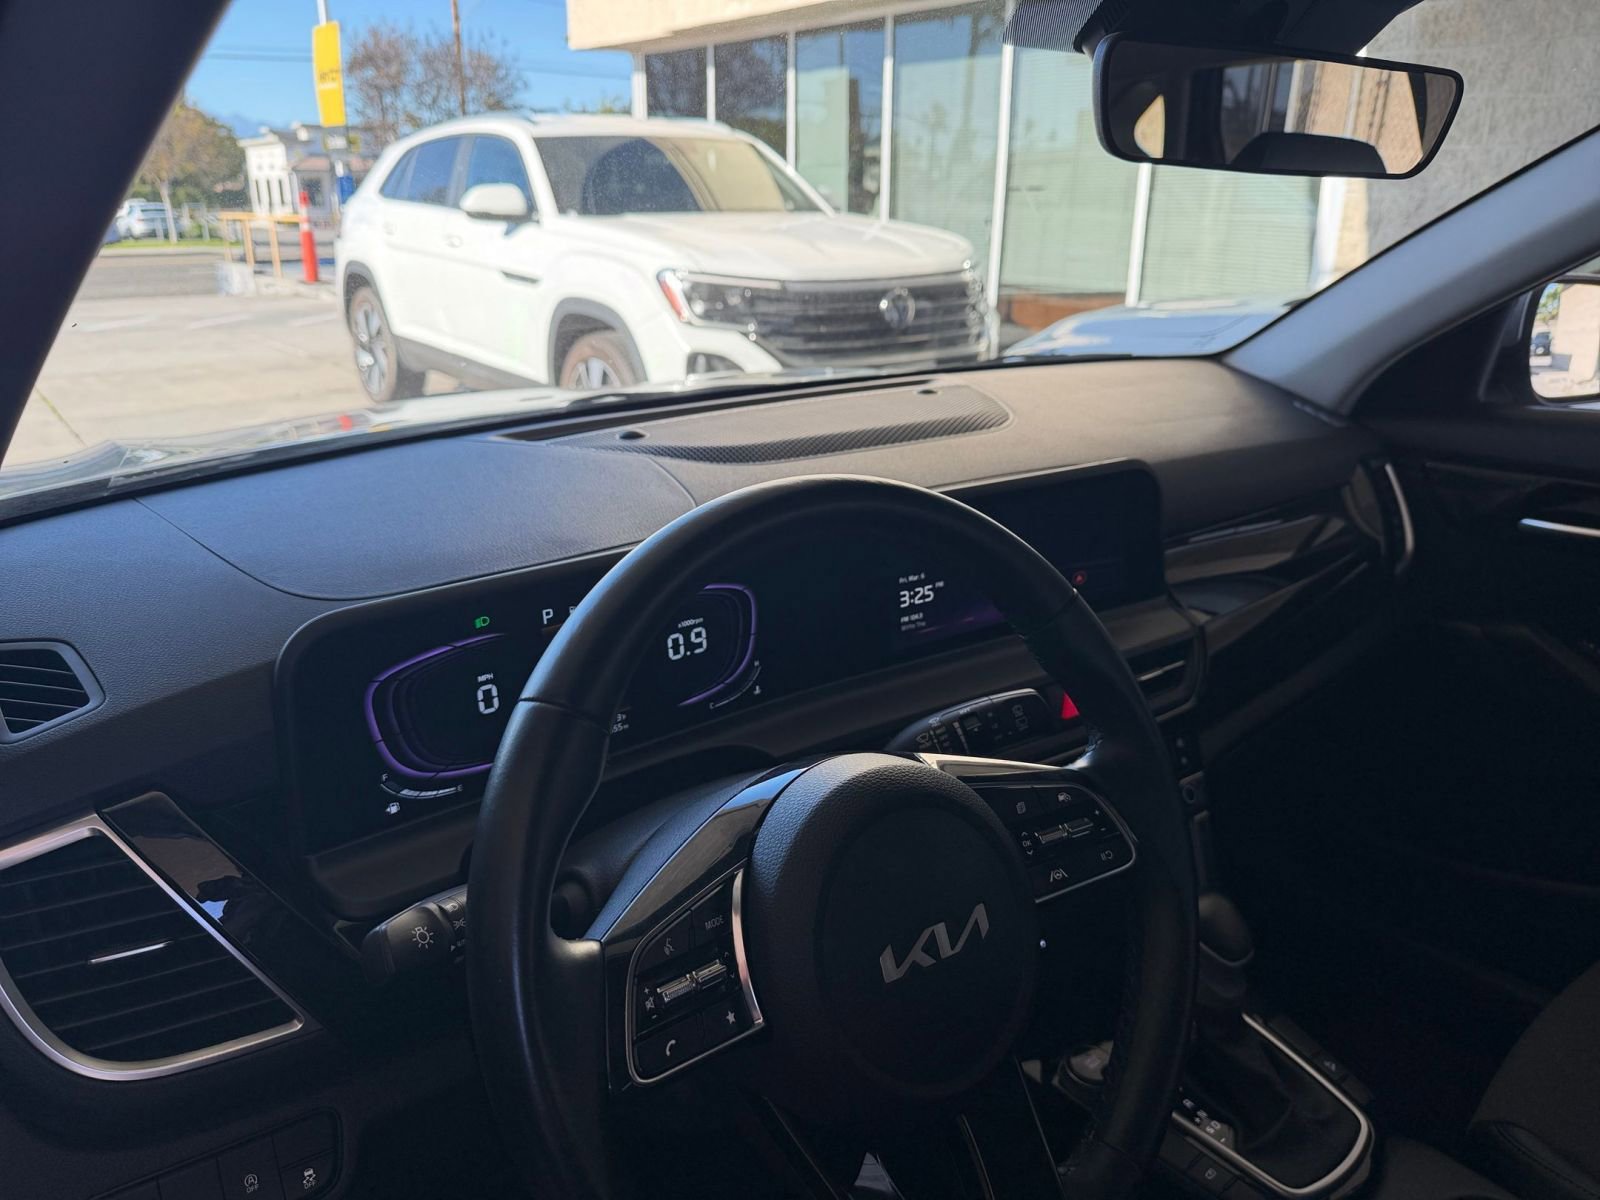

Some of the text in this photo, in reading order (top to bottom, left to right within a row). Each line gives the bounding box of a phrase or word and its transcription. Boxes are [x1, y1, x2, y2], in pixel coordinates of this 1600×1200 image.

[899, 585, 935, 608] 3:25
[542, 608, 554, 624] P
[666, 626, 708, 661] 0.9
[476, 672, 494, 683] MPH
[476, 683, 500, 715] 0
[1022, 839, 1032, 848] OK
[704, 916, 725, 930] MODE
[246, 1183, 259, 1193] OFF
[304, 1181, 316, 1189] OFF
